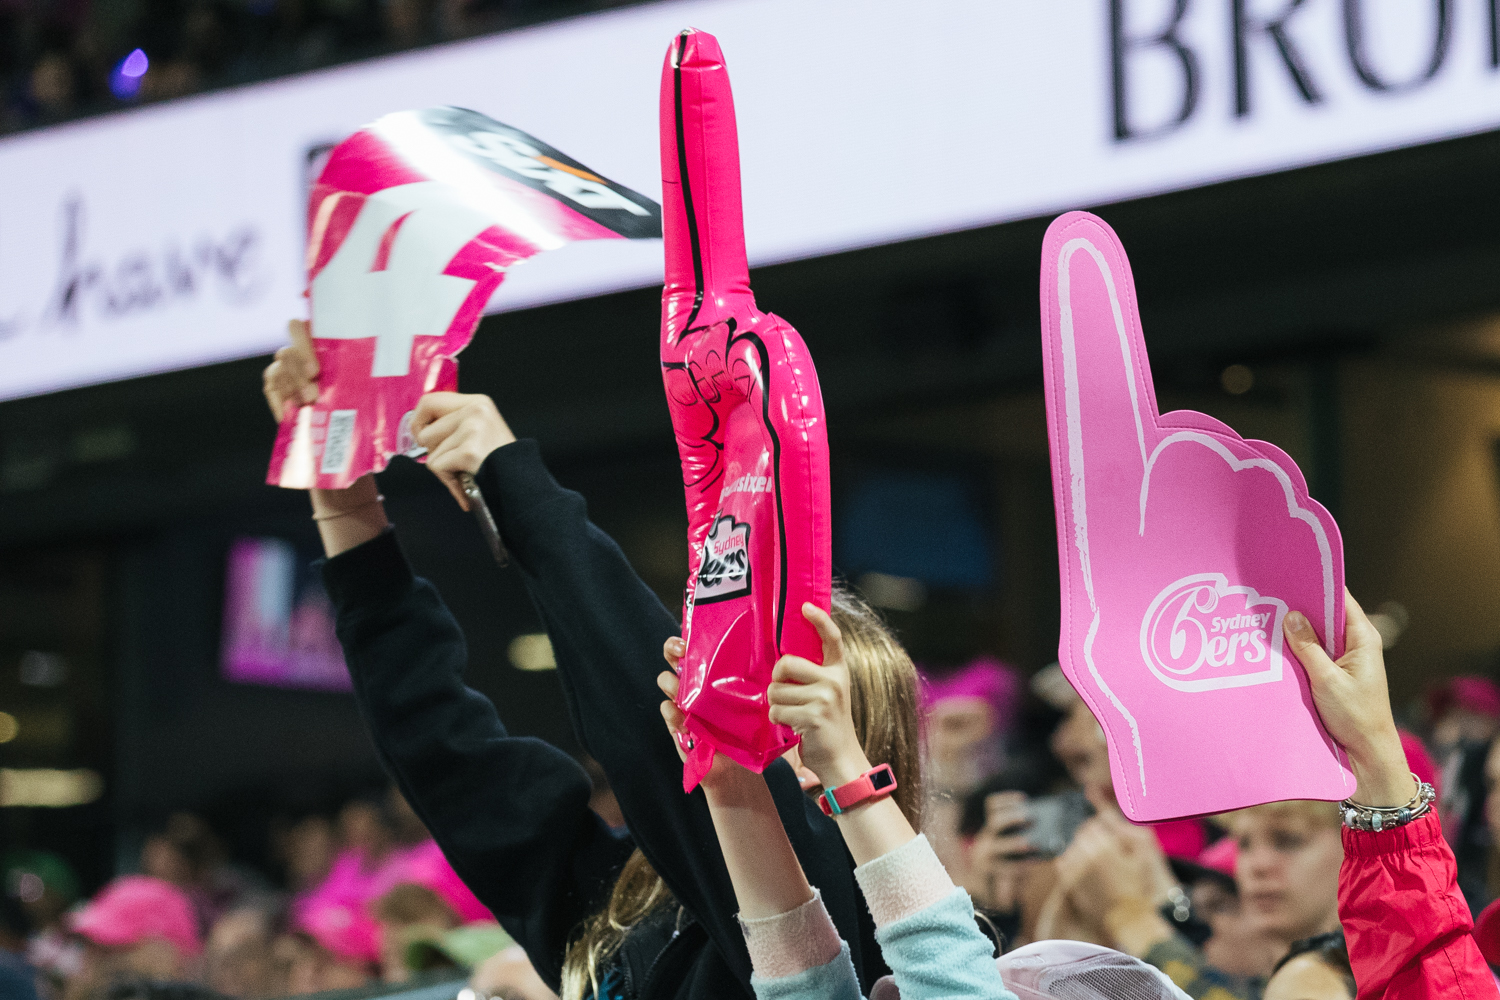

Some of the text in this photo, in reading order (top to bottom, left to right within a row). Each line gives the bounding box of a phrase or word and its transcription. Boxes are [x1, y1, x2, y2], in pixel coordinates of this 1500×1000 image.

[311, 180, 490, 377] 4
[713, 533, 745, 556] Sydney
[1151, 585, 1267, 675] 6ers
[1210, 612, 1271, 634] Sydney
